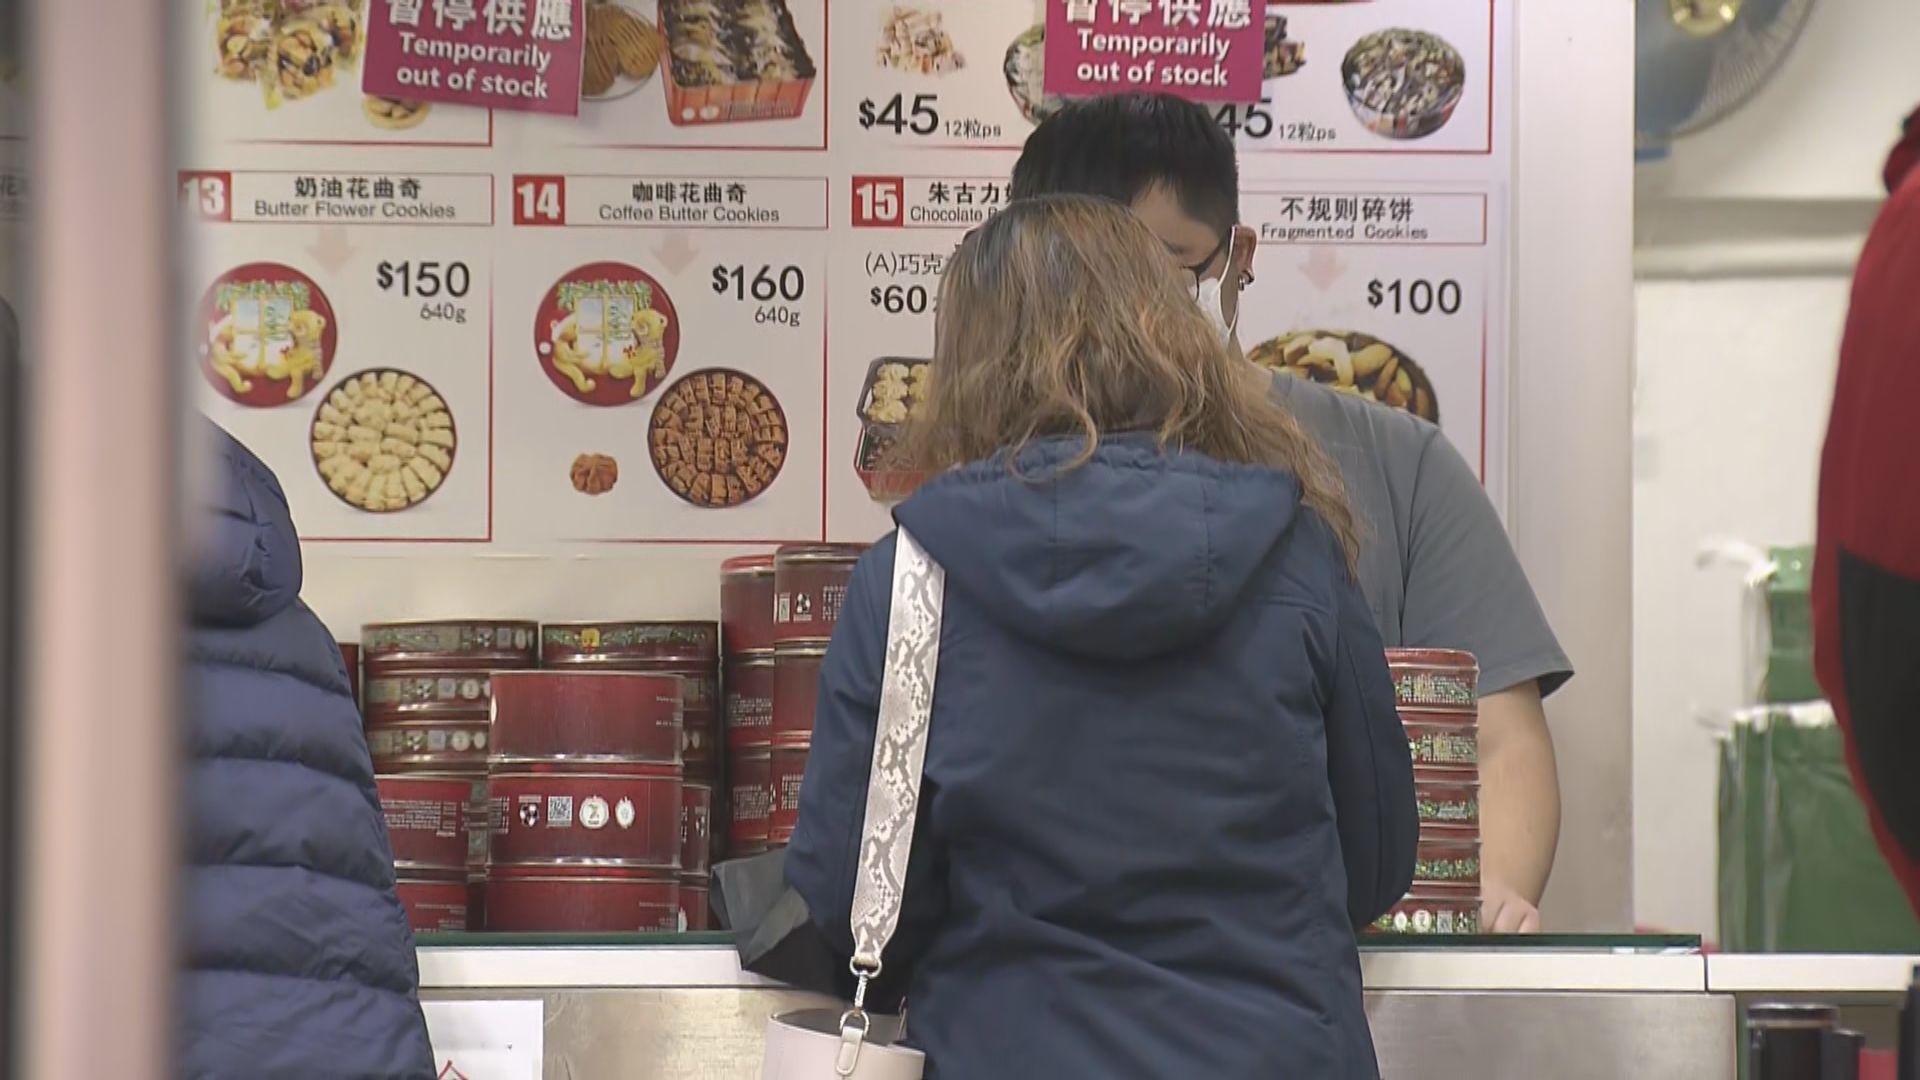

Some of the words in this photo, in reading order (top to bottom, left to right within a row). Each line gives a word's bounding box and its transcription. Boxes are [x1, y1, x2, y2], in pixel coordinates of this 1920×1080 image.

[399, 31, 551, 73] Temporarily
[1077, 28, 1231, 61] Temporarily
[397, 67, 440, 87] out
[447, 69, 477, 90] of
[481, 75, 549, 99] stock
[1077, 62, 1120, 82] out
[1127, 61, 1155, 82] of
[1161, 64, 1229, 86] stock
[858, 92, 939, 136] $45
[183, 176, 224, 216] 13
[294, 177, 422, 200] 奶油花曲奇
[517, 182, 561, 220] 14
[632, 180, 747, 204] 咖啡花曲奇
[856, 183, 899, 221] 15
[254, 200, 308, 216] Butter
[315, 202, 375, 218] Flower
[382, 202, 456, 219] Cookies
[599, 204, 653, 221] Coffee
[659, 205, 708, 221] Butter
[713, 206, 779, 223] Cookies
[910, 206, 983, 222] Chocolate
[1280, 196, 1414, 222] 不规则碎饼
[1261, 223, 1355, 240] Fragmented
[1364, 223, 1428, 240] Cookies
[376, 259, 470, 298] $150
[712, 264, 805, 302] $160
[870, 284, 928, 314] $60
[1367, 278, 1462, 315] $100
[420, 302, 467, 323] 640g
[754, 305, 801, 327] 640g
